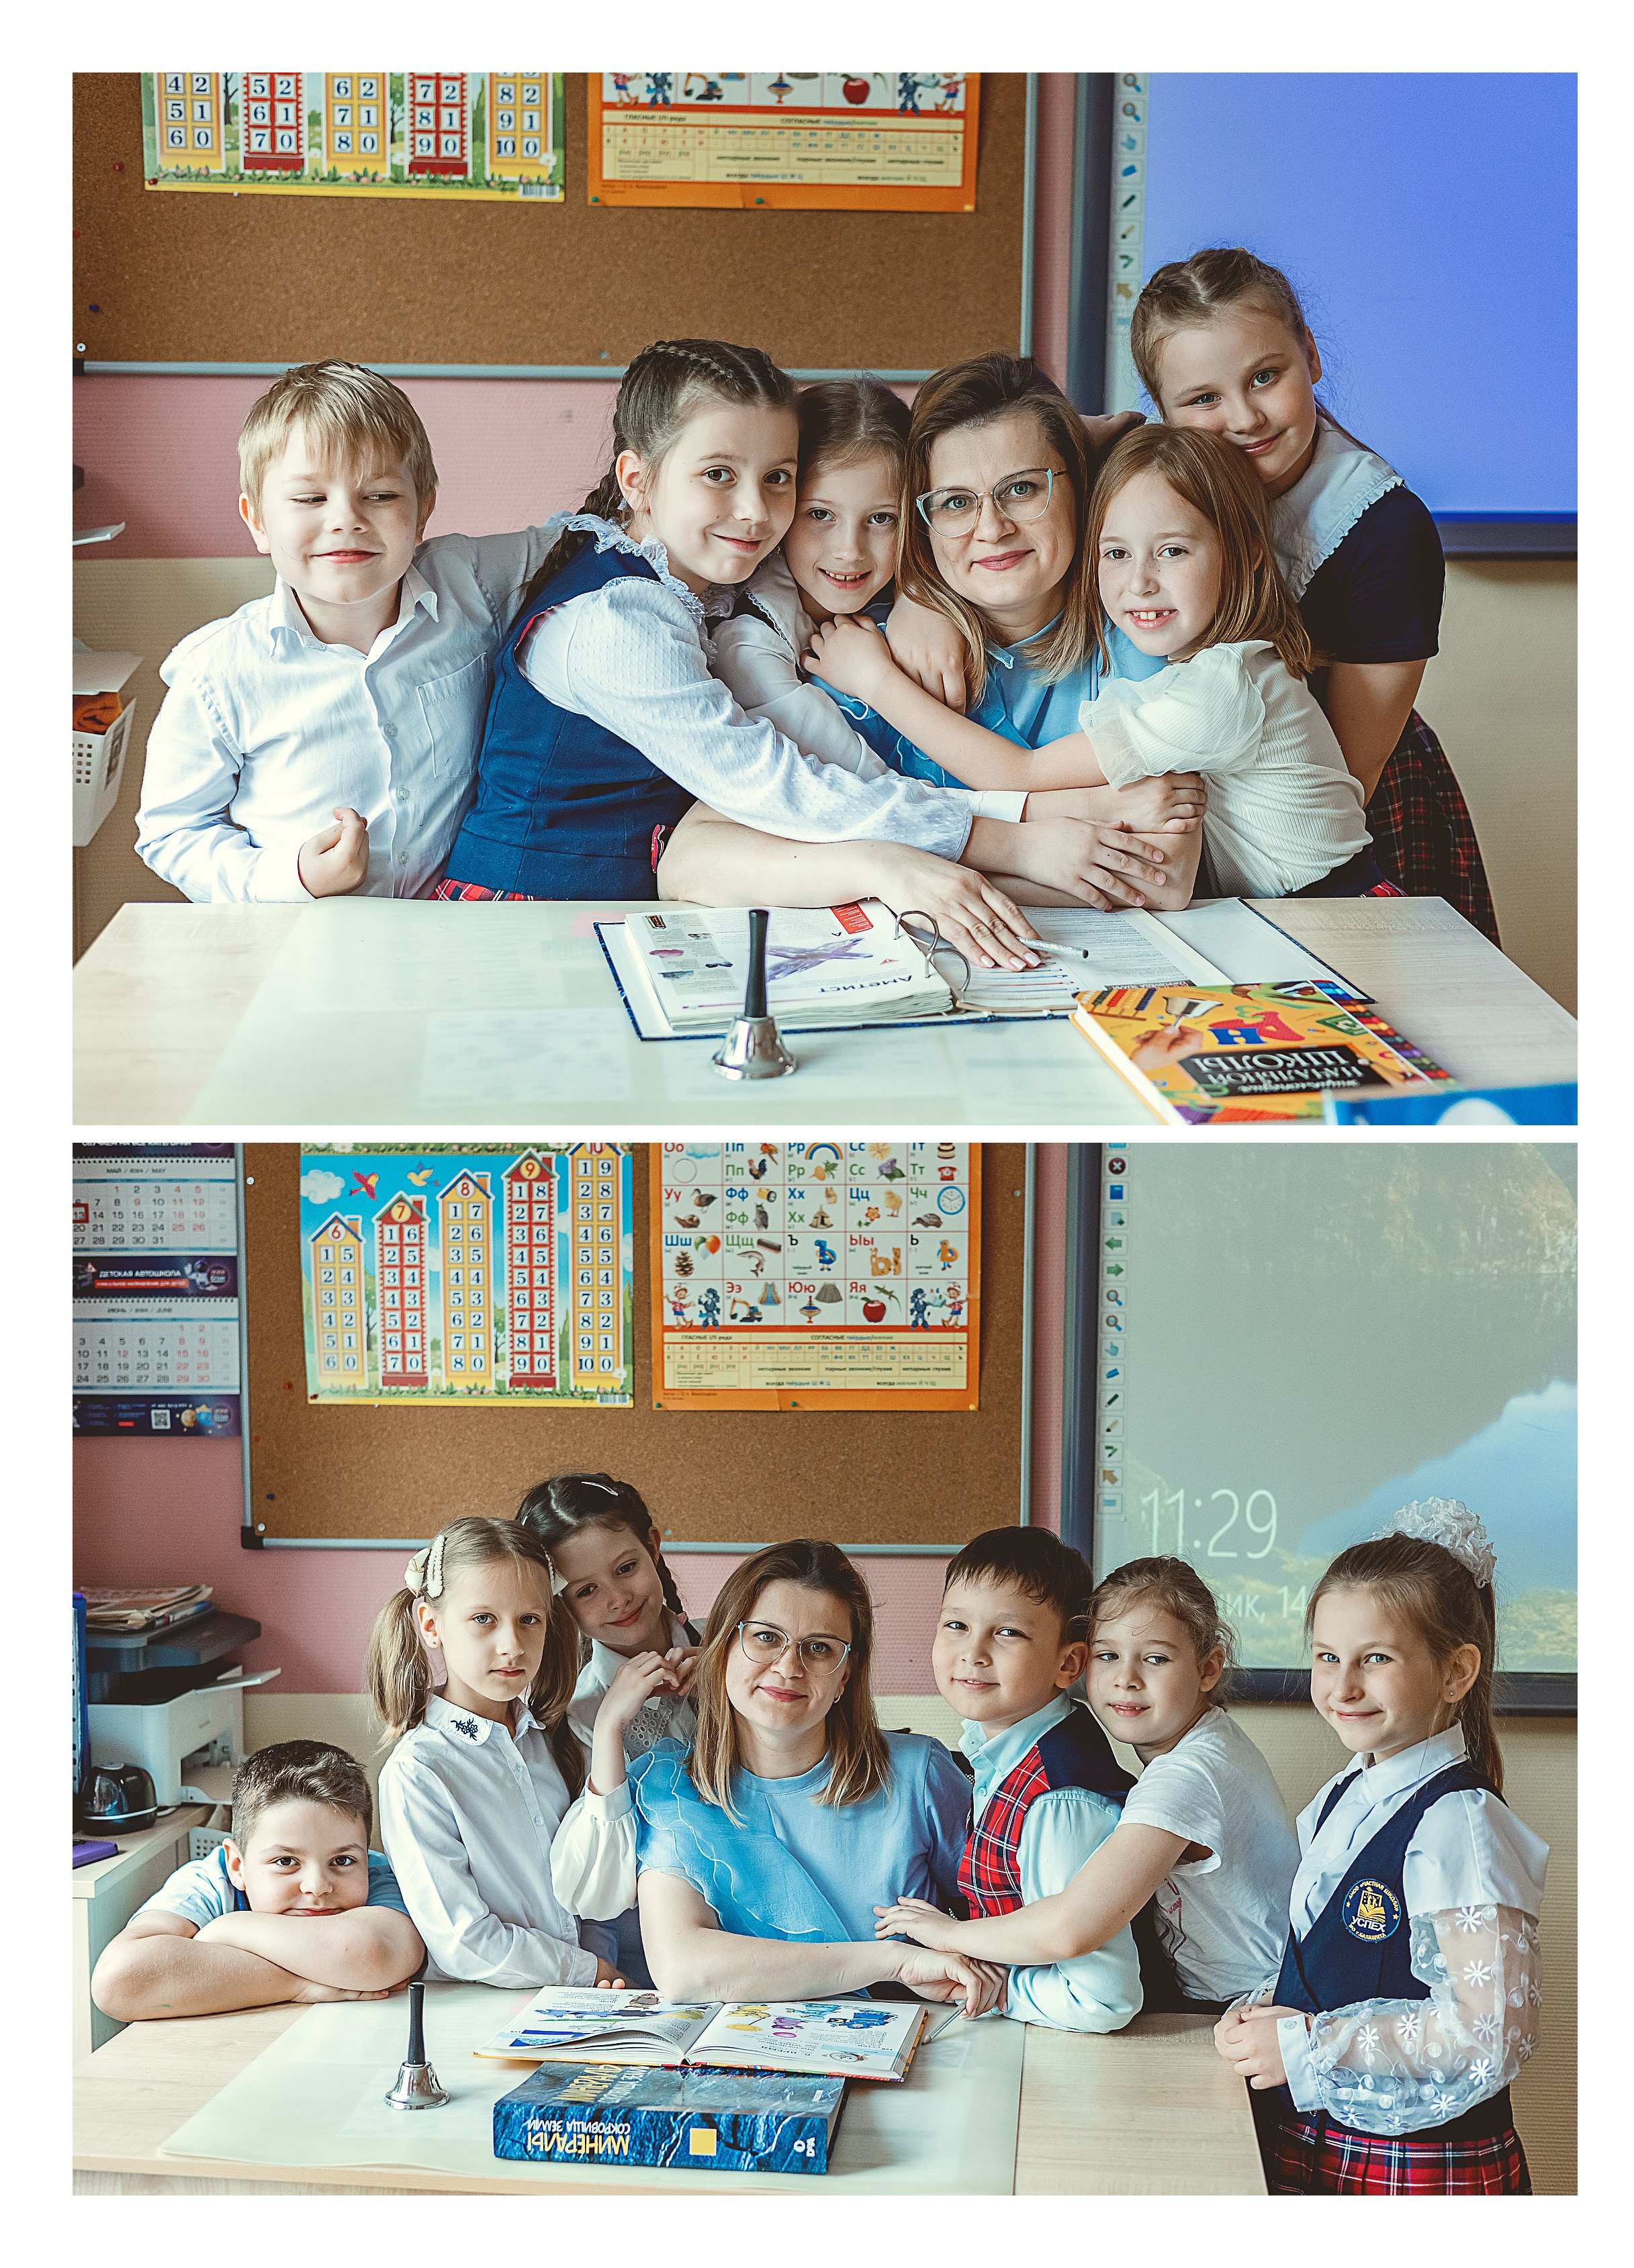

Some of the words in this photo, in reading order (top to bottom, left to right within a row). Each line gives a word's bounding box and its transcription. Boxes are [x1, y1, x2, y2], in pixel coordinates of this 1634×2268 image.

[169, 77, 179, 91] 4
[196, 77, 207, 91] 2
[254, 79, 265, 93] 5
[280, 81, 291, 95] 2
[337, 81, 348, 95] 6
[363, 83, 373, 97] 2
[421, 85, 430, 98] 7
[446, 86, 456, 99] 2
[500, 88, 512, 100] 8
[527, 89, 537, 103] 2
[171, 103, 182, 117] 5
[199, 105, 204, 119] 1
[254, 106, 265, 120] 6
[284, 107, 289, 122] 1
[338, 109, 349, 123] 7
[366, 110, 371, 124] 1
[419, 112, 430, 124] 8
[449, 113, 453, 126] 1
[500, 114, 512, 128] 9
[529, 115, 533, 129] 1
[171, 130, 182, 144] 6
[197, 132, 208, 145] 0
[255, 134, 266, 147] 7
[281, 135, 291, 147] 0
[338, 136, 350, 148] 8
[363, 137, 375, 150] 0
[419, 139, 430, 152] 9
[445, 140, 457, 152] 0
[497, 140, 515, 154] 10
[526, 142, 537, 154] 0
[818, 975, 911, 993] Аметист
[1191, 1051, 1352, 1073] ШКОЛЫ
[1207, 1067, 1364, 1086] НАЧАЛЬНОЙ
[526, 1163, 535, 1176] 9
[726, 1165, 744, 1176] Пп
[788, 1165, 805, 1178] Рр
[850, 1164, 865, 1175] Сс
[911, 1164, 925, 1174] Тт
[461, 1182, 469, 1196] 8
[665, 1189, 681, 1202] Уу
[726, 1188, 748, 1202] Фф
[788, 1188, 805, 1199] Хх
[850, 1188, 870, 1202] Цц
[911, 1188, 927, 1198] Чч
[398, 1205, 405, 1219] 7
[726, 1212, 748, 1225] Фф
[788, 1212, 805, 1223] Хх
[332, 1226, 341, 1239] 6
[389, 1229, 392, 1239] 1
[408, 1229, 416, 1239] 6
[666, 1235, 691, 1246] Шш
[726, 1235, 754, 1249] Щщ
[788, 1235, 798, 1245] Ъ
[850, 1235, 874, 1245] Ыы
[911, 1235, 919, 1245] Ь
[388, 1251, 396, 1262] 2
[408, 1250, 416, 1262] 5
[388, 1272, 396, 1283] 3
[407, 1272, 416, 1283] 4
[726, 1282, 741, 1293] Ээ
[788, 1282, 815, 1293] Юю
[850, 1282, 866, 1292] Яя
[387, 1294, 396, 1305] 4
[408, 1294, 416, 1305] 3
[389, 1315, 398, 1326] 5
[409, 1315, 417, 1326] 2
[390, 1337, 398, 1346] 6
[412, 1337, 416, 1347] 1
[391, 1358, 398, 1368] 7
[410, 1358, 418, 1368] 0
[1142, 1489, 1277, 1558] 11:29
[1351, 1916, 1386, 1932] УСПЕХ
[527, 2119, 563, 2132] ЗЕМЛИ
[567, 2119, 631, 2134] СОКРОВИЩА
[527, 2131, 630, 2156] МИНЕРАЛЫ
